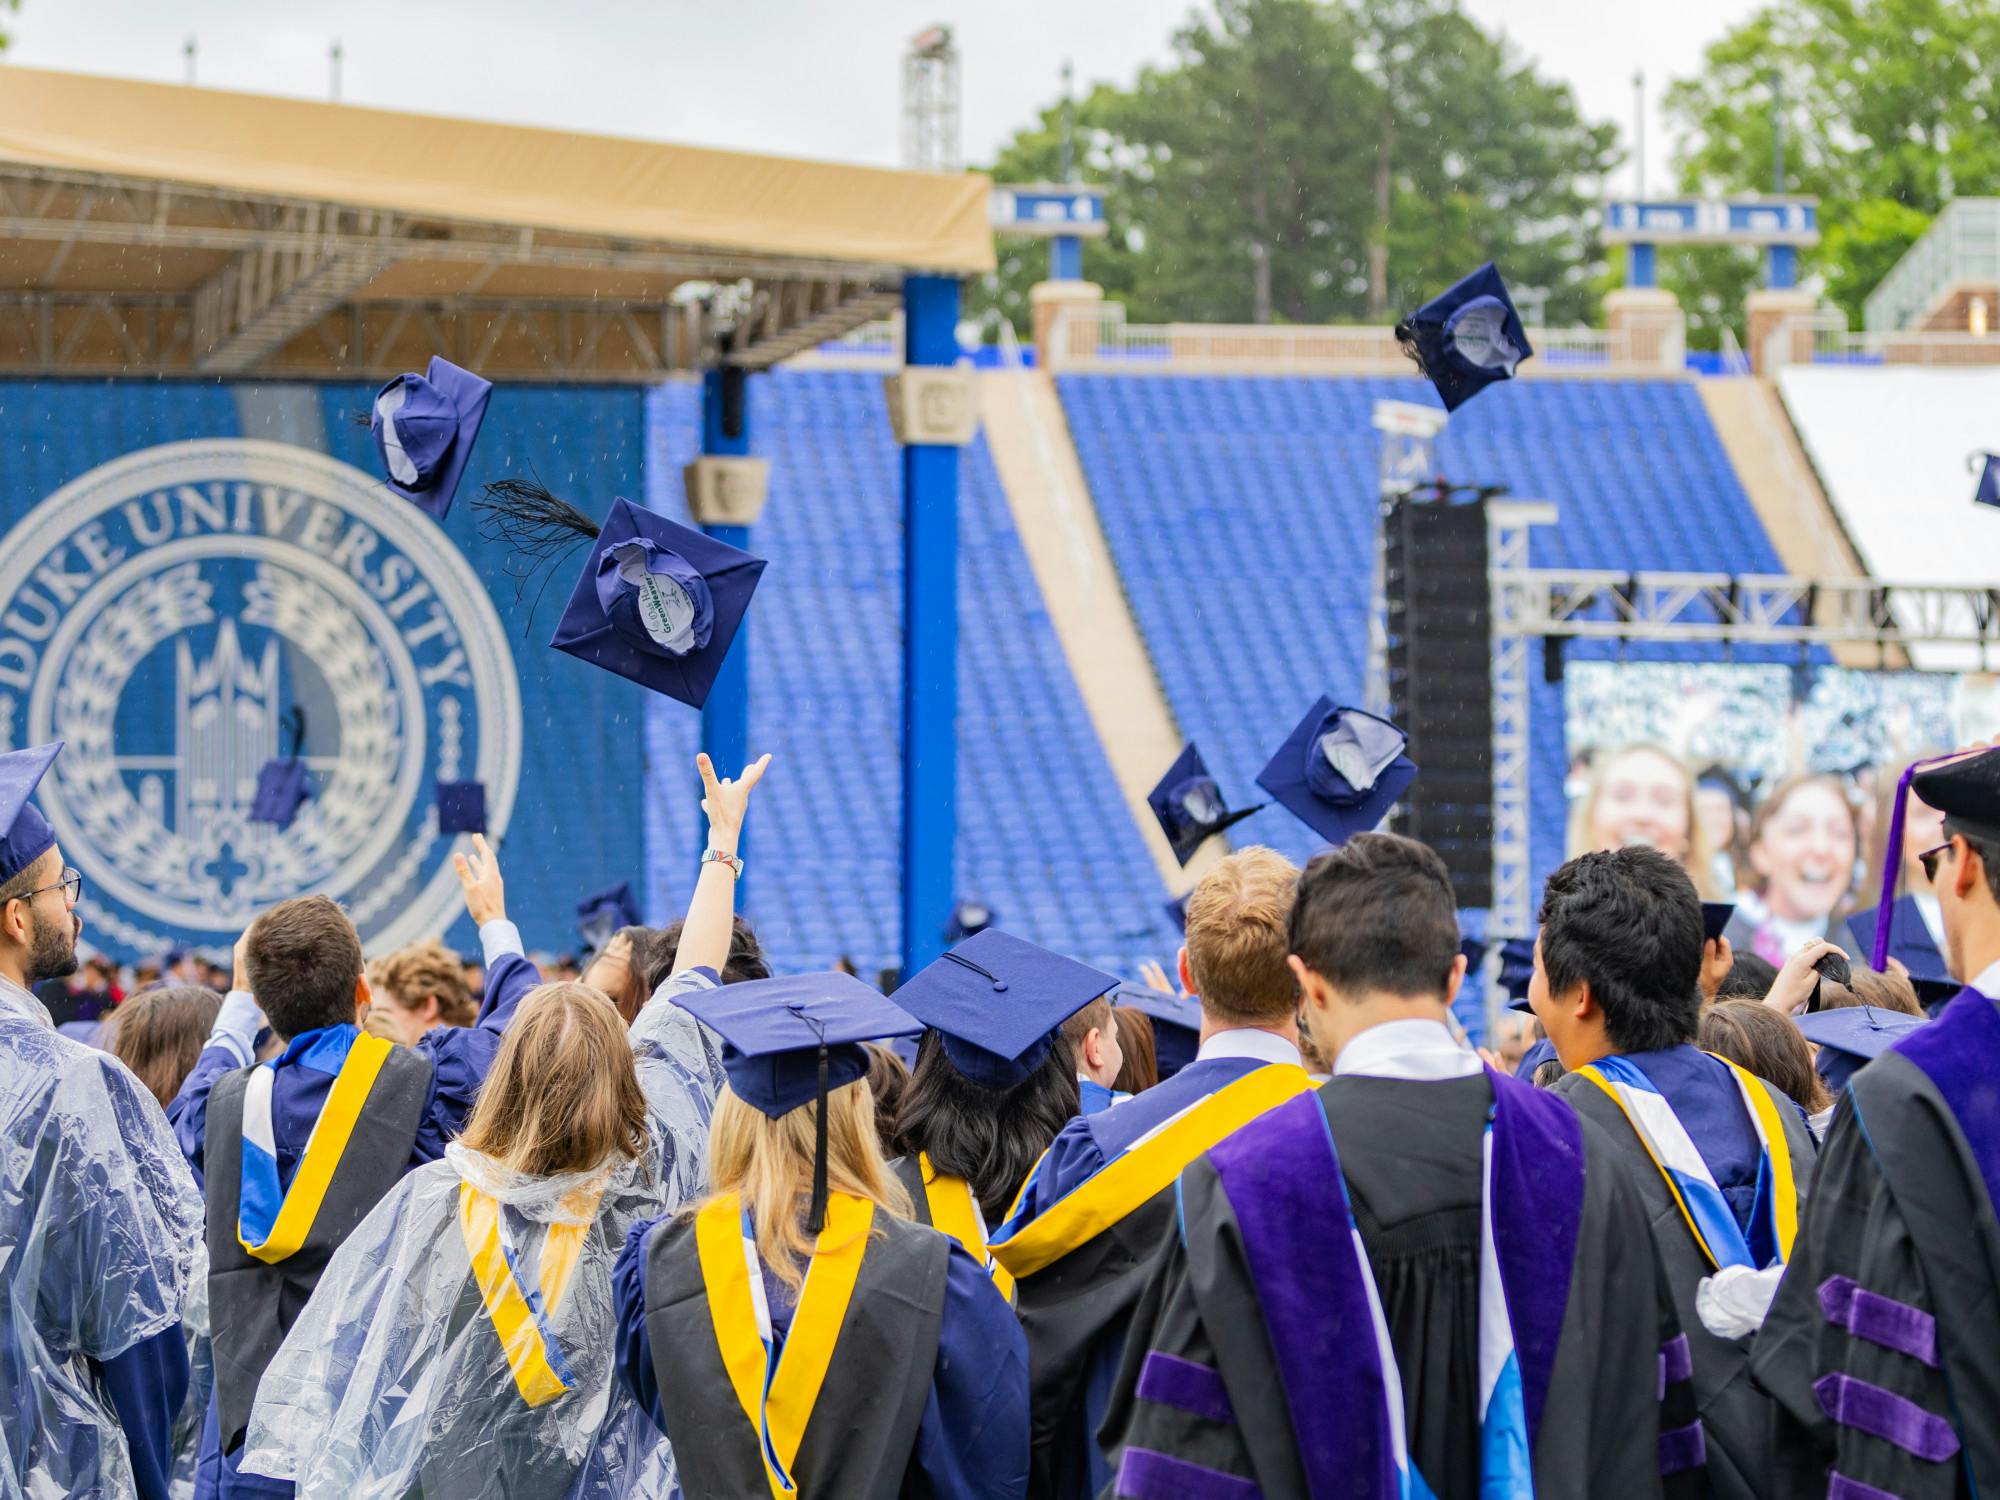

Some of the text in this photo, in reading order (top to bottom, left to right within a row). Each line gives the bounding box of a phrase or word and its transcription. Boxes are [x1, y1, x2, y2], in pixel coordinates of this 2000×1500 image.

[0, 482, 473, 691] DUKE UNIVERSITY
[645, 576, 671, 634] GreenWeaver
